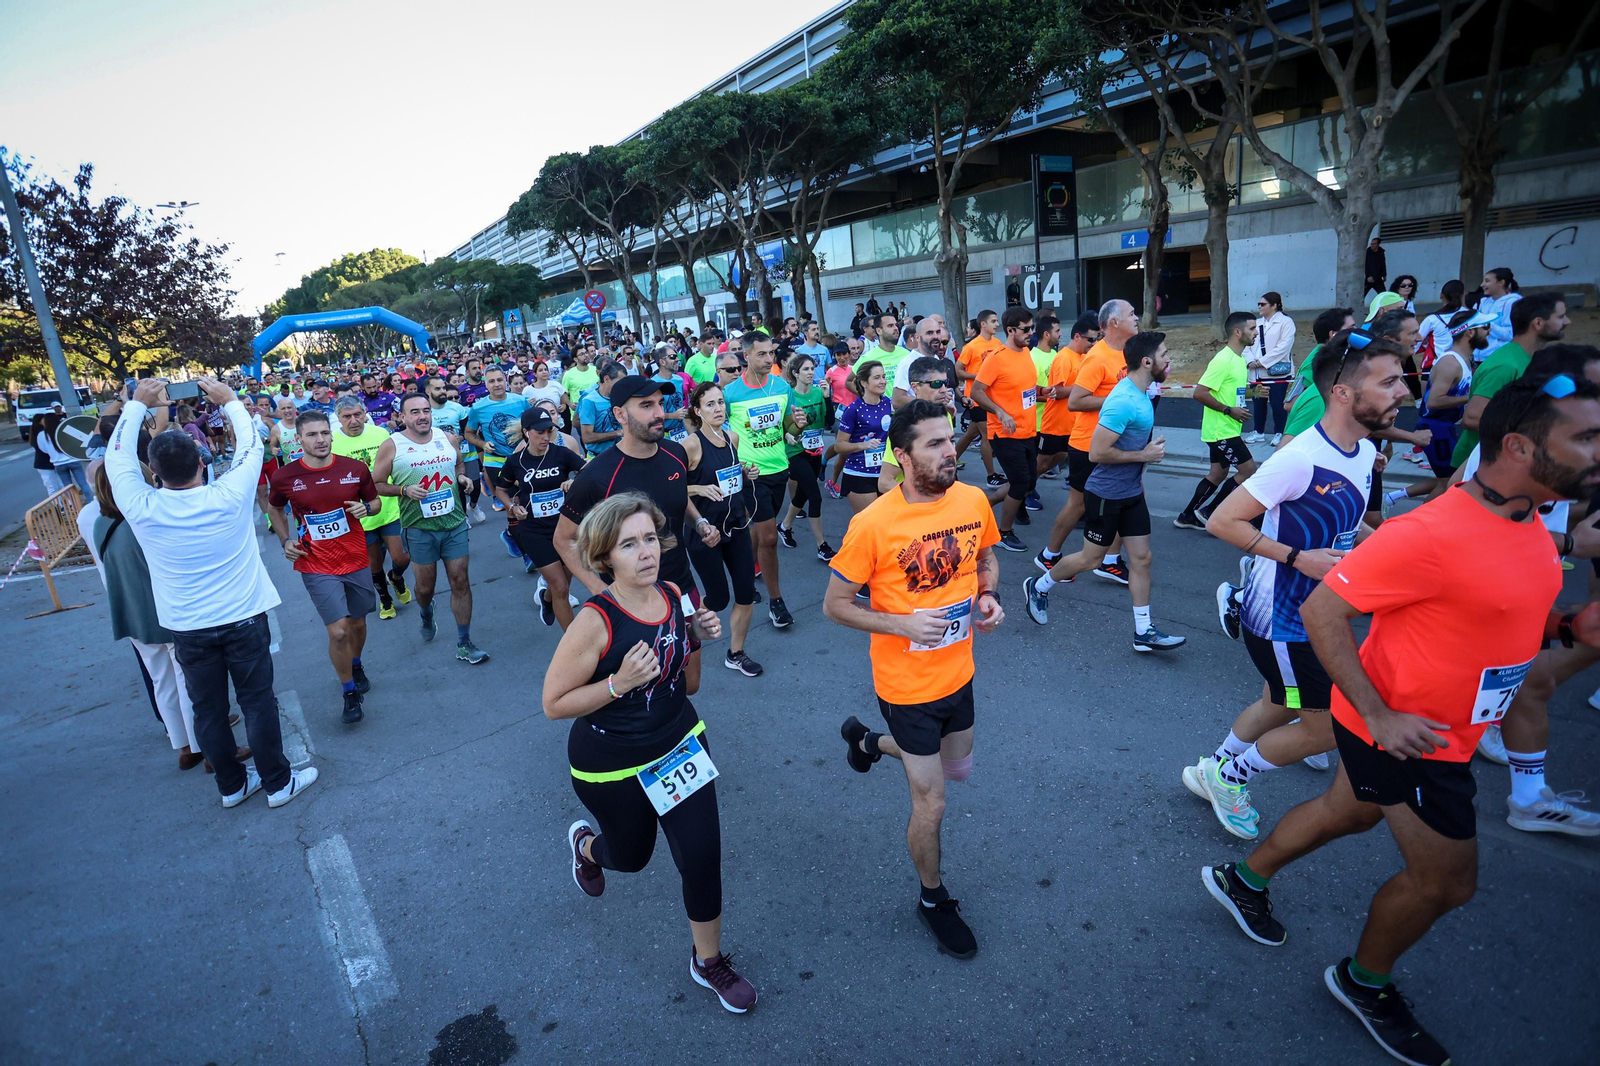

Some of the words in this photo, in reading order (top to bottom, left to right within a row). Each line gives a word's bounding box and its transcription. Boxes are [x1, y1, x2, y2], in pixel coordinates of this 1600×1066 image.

[1128, 234, 1136, 246] 4
[1024, 271, 1063, 309] 04
[757, 413, 775, 425] 300
[535, 467, 559, 479] asics
[728, 478, 738, 488] 32
[430, 500, 448, 511] 637
[540, 500, 559, 511] 636
[317, 522, 340, 534] 650
[922, 528, 954, 542] CARRERA
[955, 521, 981, 534] POPULAR
[661, 761, 698, 796] 519
